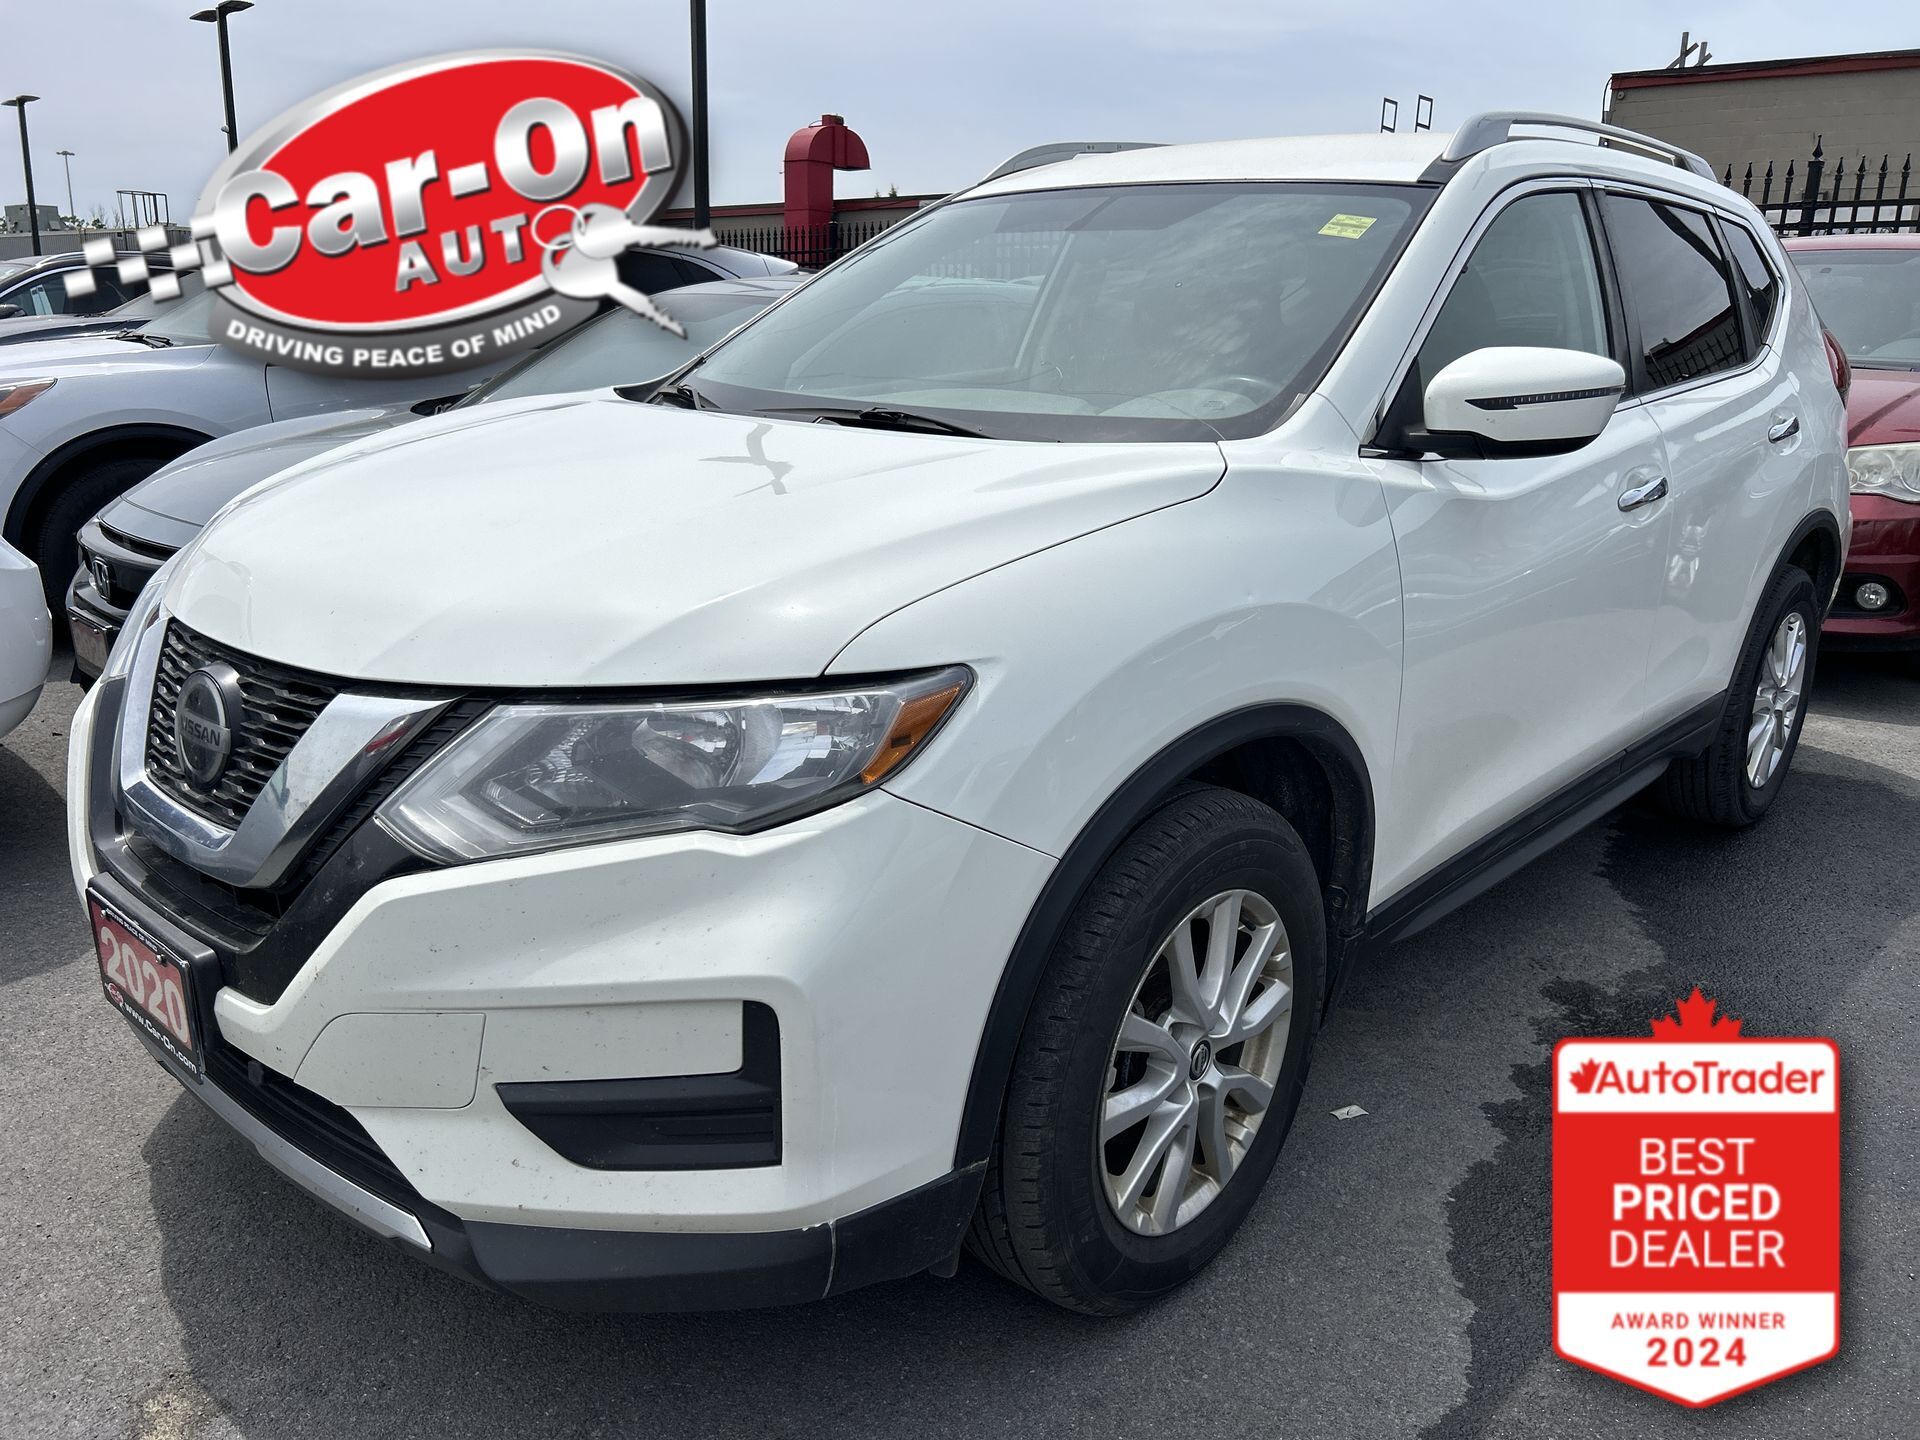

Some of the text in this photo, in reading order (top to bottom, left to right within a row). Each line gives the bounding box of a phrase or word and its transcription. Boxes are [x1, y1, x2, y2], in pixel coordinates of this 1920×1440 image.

[180, 714, 221, 747] NISSAN
[100, 926, 190, 1044] 2020
[124, 1002, 198, 1075] www.Car-On.com
